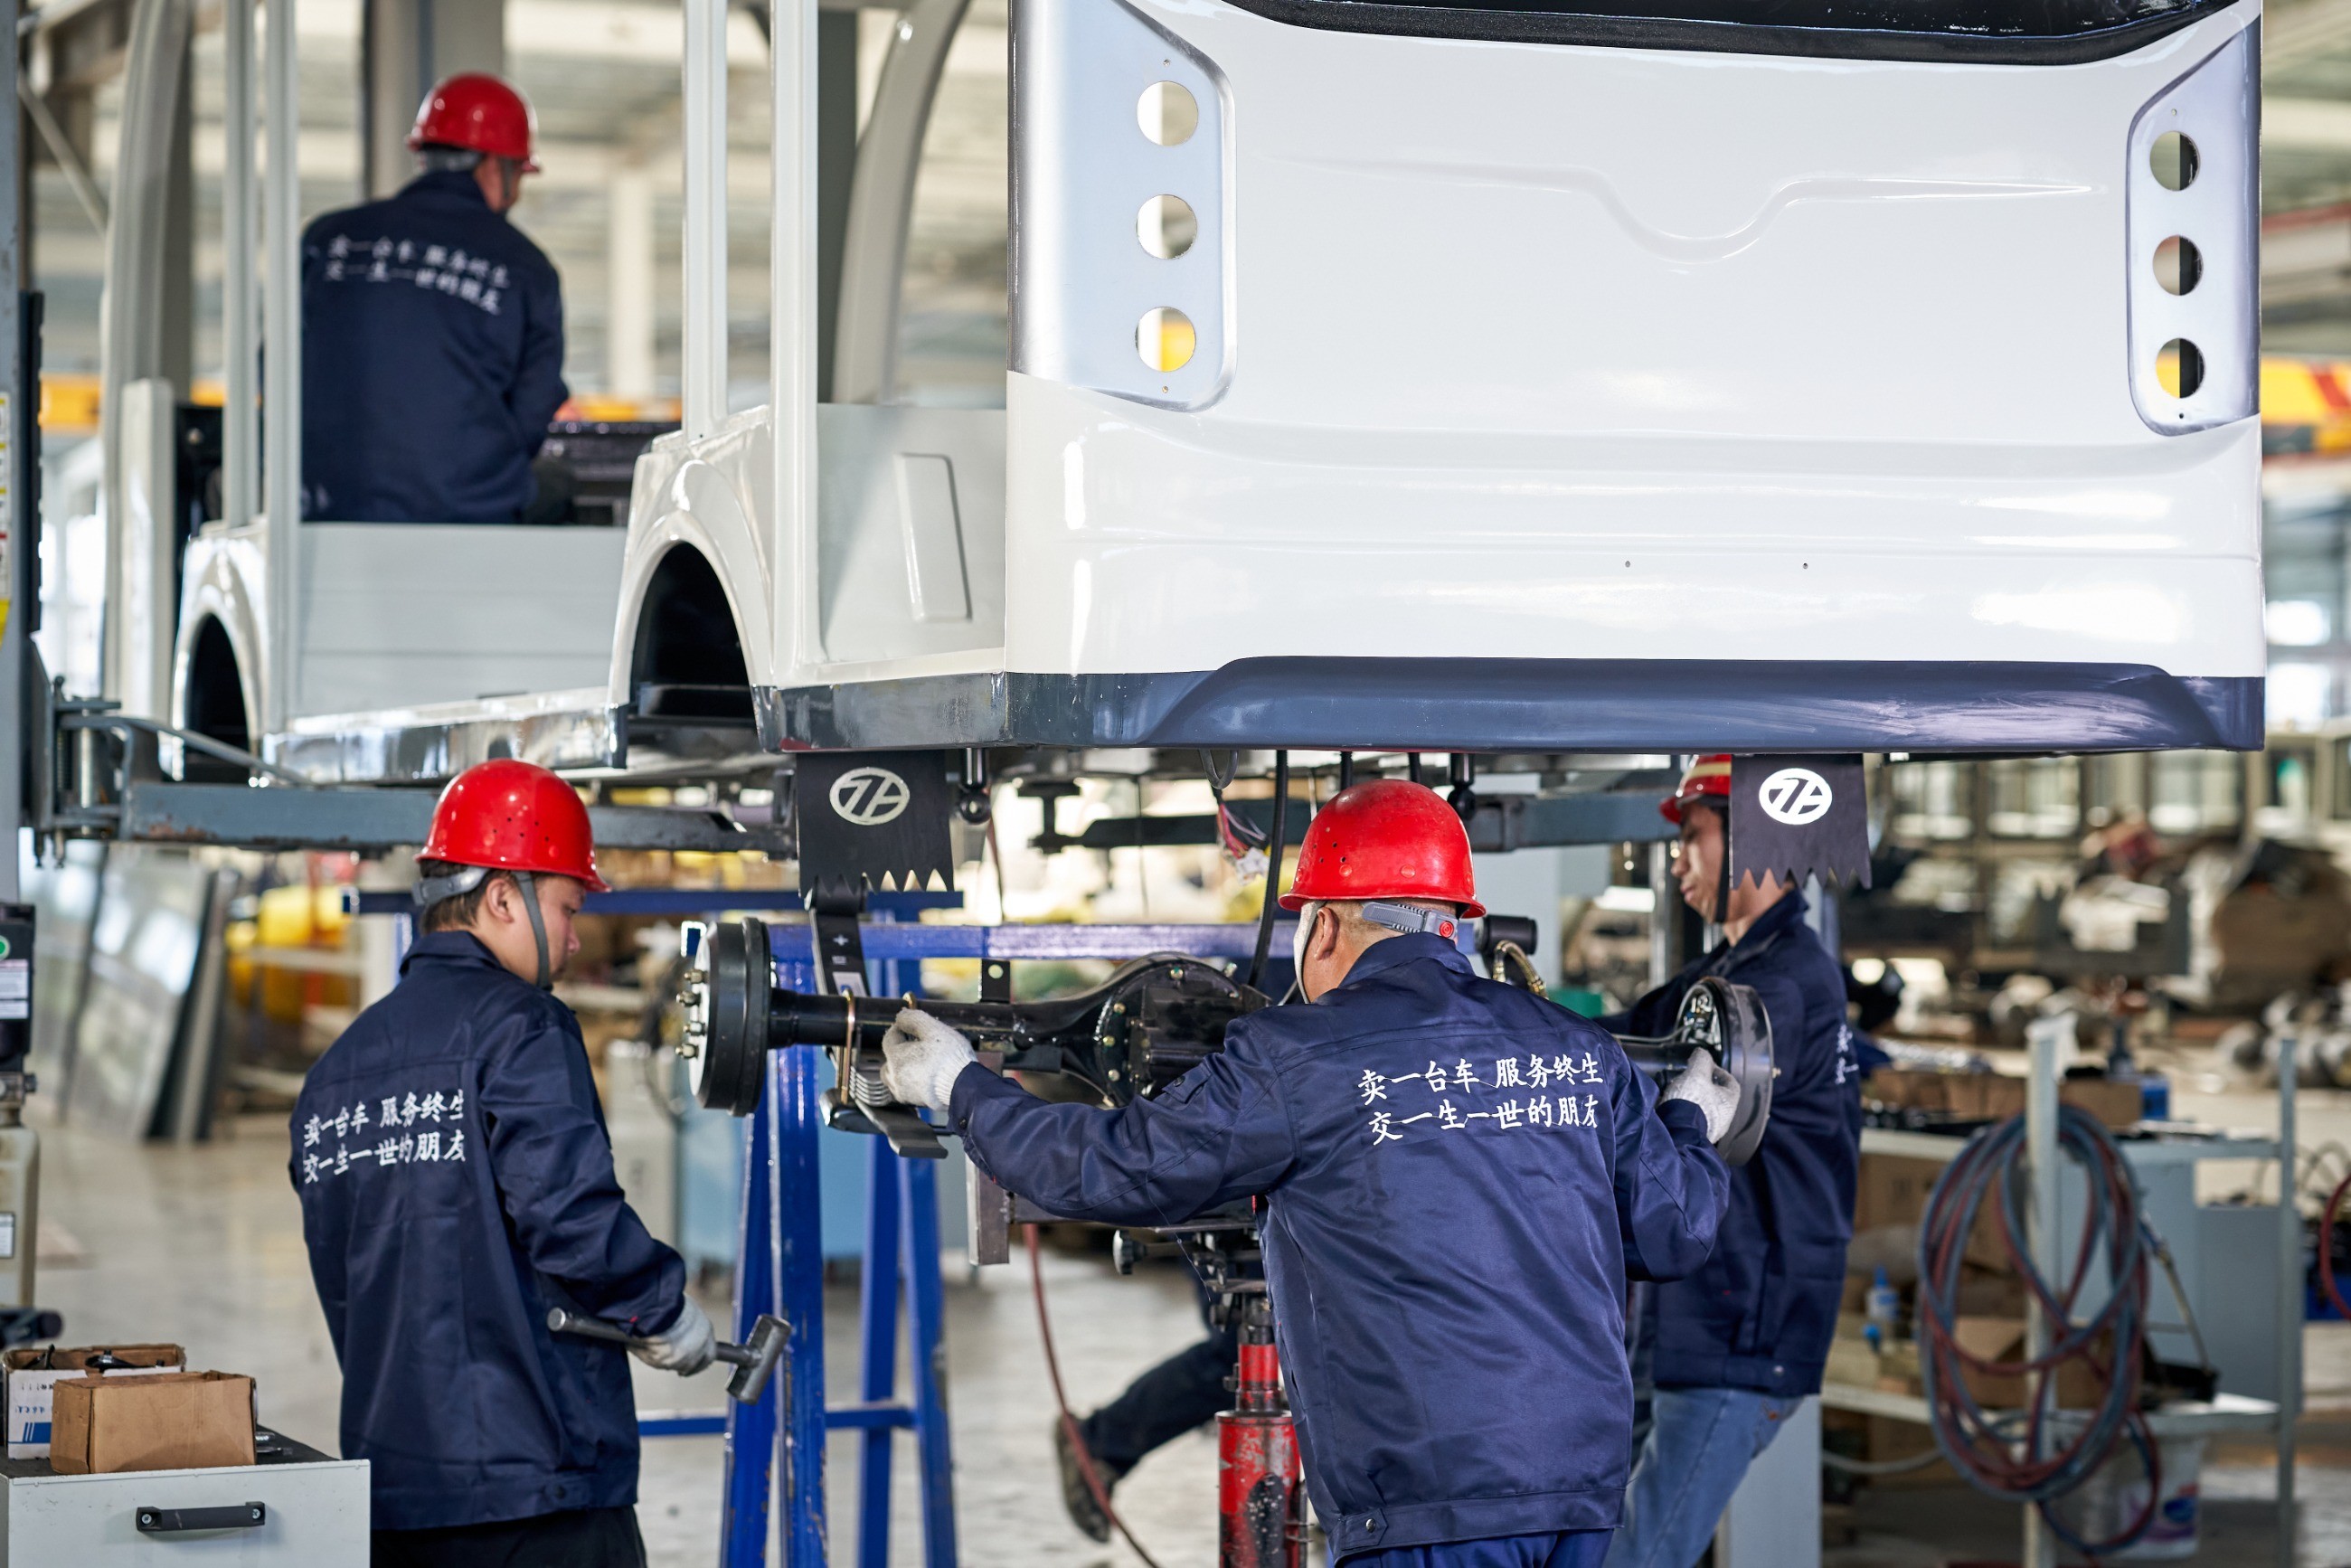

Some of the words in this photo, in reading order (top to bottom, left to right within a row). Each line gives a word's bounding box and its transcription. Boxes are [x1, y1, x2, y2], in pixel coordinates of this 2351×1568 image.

[1357, 1057, 1480, 1106] 卖一台车
[1496, 1053, 1604, 1089] 服务终生
[1368, 1093, 1600, 1147] 交一生一世的朋友
[303, 1129, 467, 1185] 交一生一世的朋友
